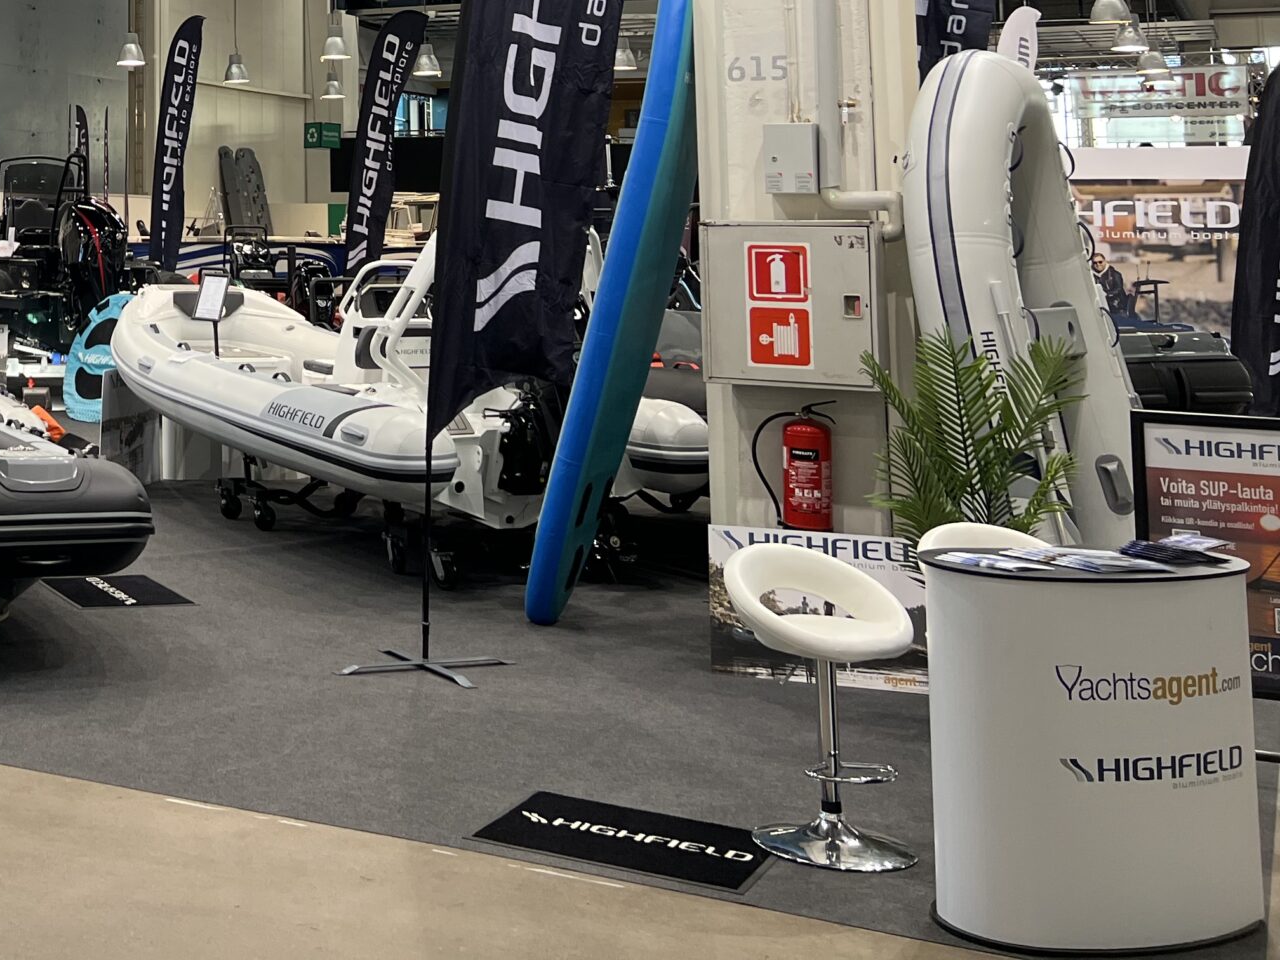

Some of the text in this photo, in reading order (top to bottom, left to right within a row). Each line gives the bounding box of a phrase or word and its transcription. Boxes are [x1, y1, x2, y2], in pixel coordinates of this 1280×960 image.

[184, 43, 198, 103] explore
[728, 55, 789, 82] 615
[353, 33, 400, 236] HIGHFIELD
[268, 402, 325, 429] HIGHFIELD
[1160, 477, 1195, 495] Voita
[1160, 496, 1172, 506] tai
[1174, 499, 1200, 508] muita
[1056, 664, 1241, 705] Yachtsagent.com
[1097, 745, 1242, 782] HIGHFIELD
[552, 817, 754, 862] HIGHFIELD
